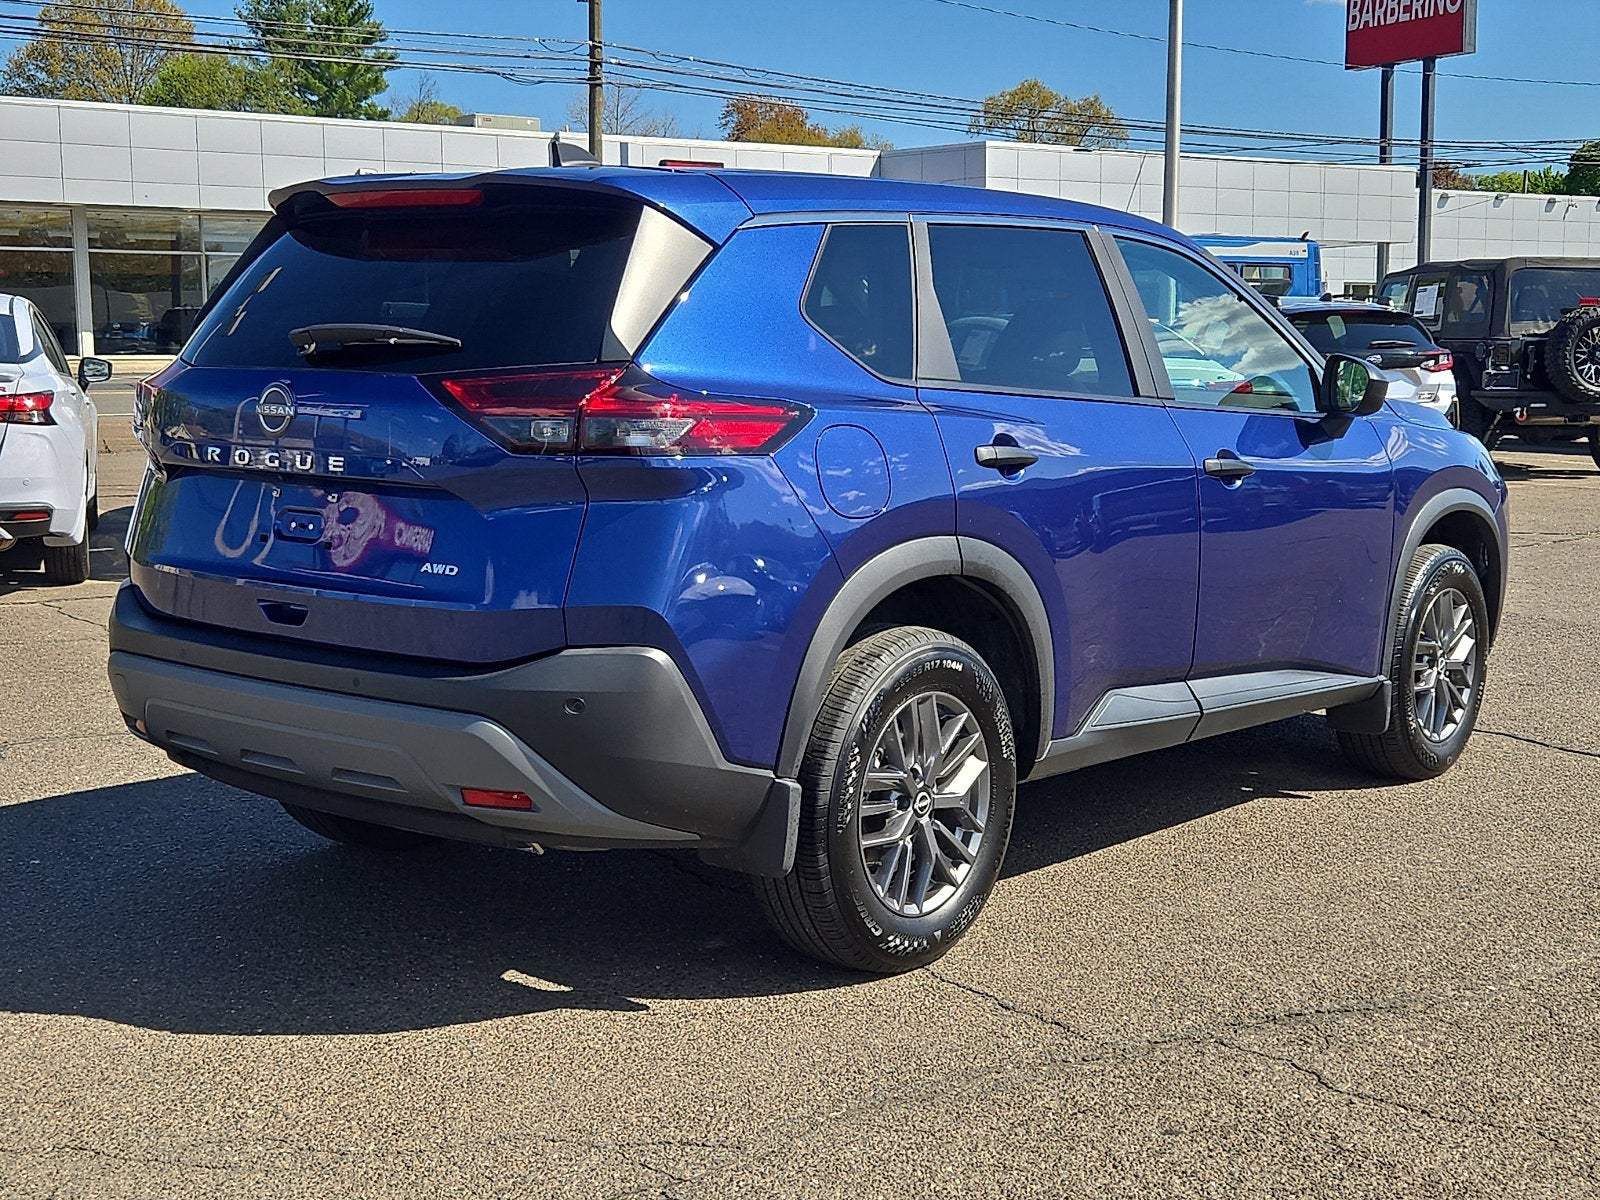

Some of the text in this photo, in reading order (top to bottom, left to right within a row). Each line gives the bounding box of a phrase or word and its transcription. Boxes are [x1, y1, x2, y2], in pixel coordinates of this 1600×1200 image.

[256, 405, 295, 417] NISSAN
[207, 446, 345, 472] ROGUE
[420, 562, 459, 576] AWD
[924, 660, 941, 672] R17
